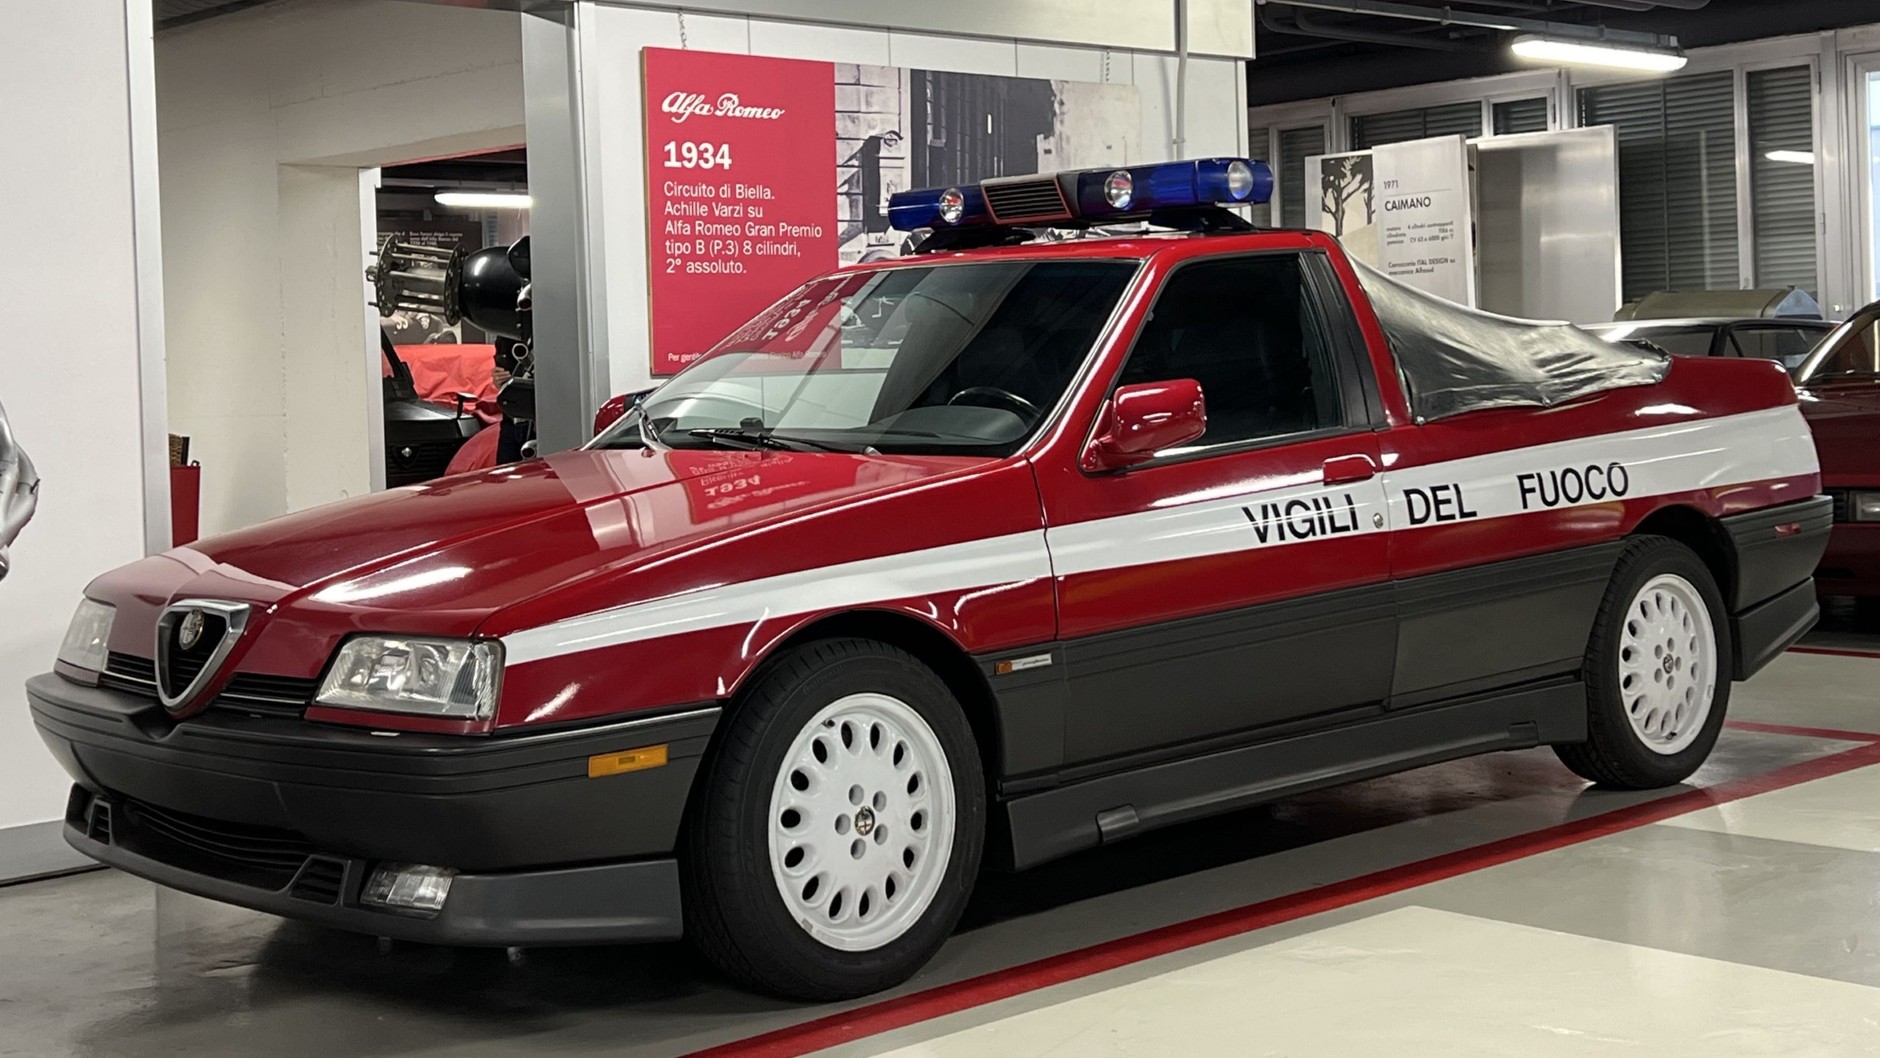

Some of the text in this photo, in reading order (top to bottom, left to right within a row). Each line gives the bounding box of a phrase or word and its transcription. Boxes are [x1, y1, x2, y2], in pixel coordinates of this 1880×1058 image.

[661, 91, 785, 123] Alfa Romeo
[663, 140, 732, 170] 1934
[663, 181, 775, 200] Circuito di Biella.
[1384, 179, 1398, 189] 1971
[664, 201, 763, 218] Achille Varzi su
[1384, 196, 1431, 211] CAIMANO
[665, 220, 822, 238] Alfa Romeo Gran Premio
[665, 240, 801, 258] tipo B (P.3) 8 cilindri,
[686, 259, 747, 274] assoluto.
[1241, 462, 1630, 544] VIGILI DEL FUOCO
